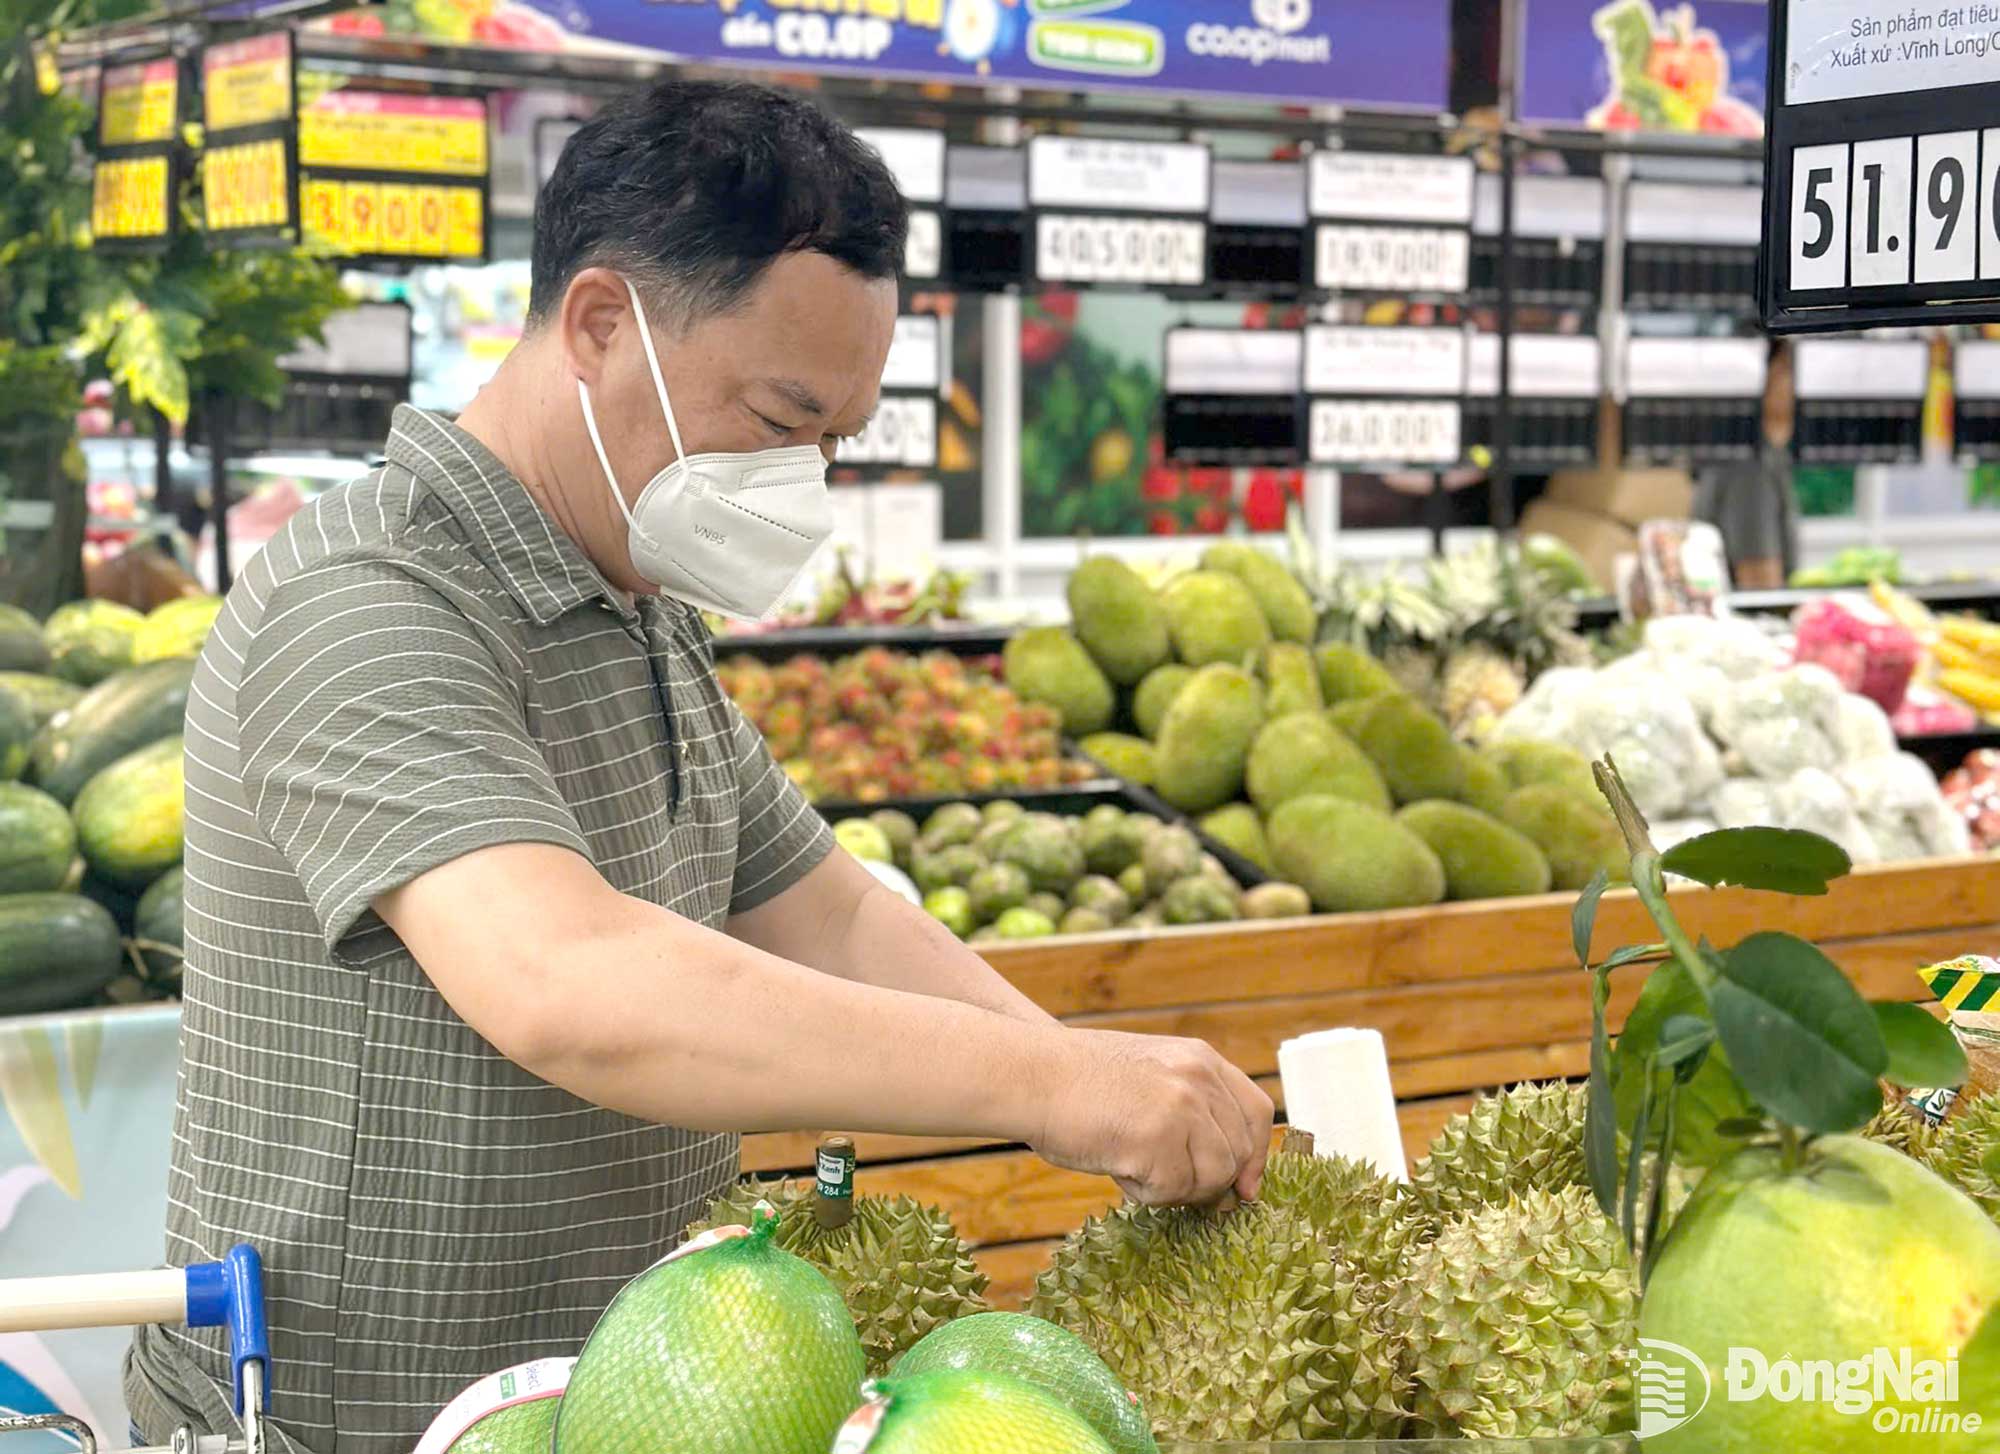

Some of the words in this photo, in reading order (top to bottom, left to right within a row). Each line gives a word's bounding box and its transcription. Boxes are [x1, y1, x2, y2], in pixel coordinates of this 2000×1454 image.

[1850, 16, 1882, 38] Sản
[1887, 8, 1932, 38] phẩm
[1938, 8, 1964, 31] đạt
[1969, 4, 1999, 25] tiêu
[1830, 43, 1867, 68] Xuất
[1871, 43, 1892, 64] xứ
[1802, 156, 2000, 259] 51.9
[693, 523, 727, 545] VN95
[824, 1185, 839, 1196] 284
